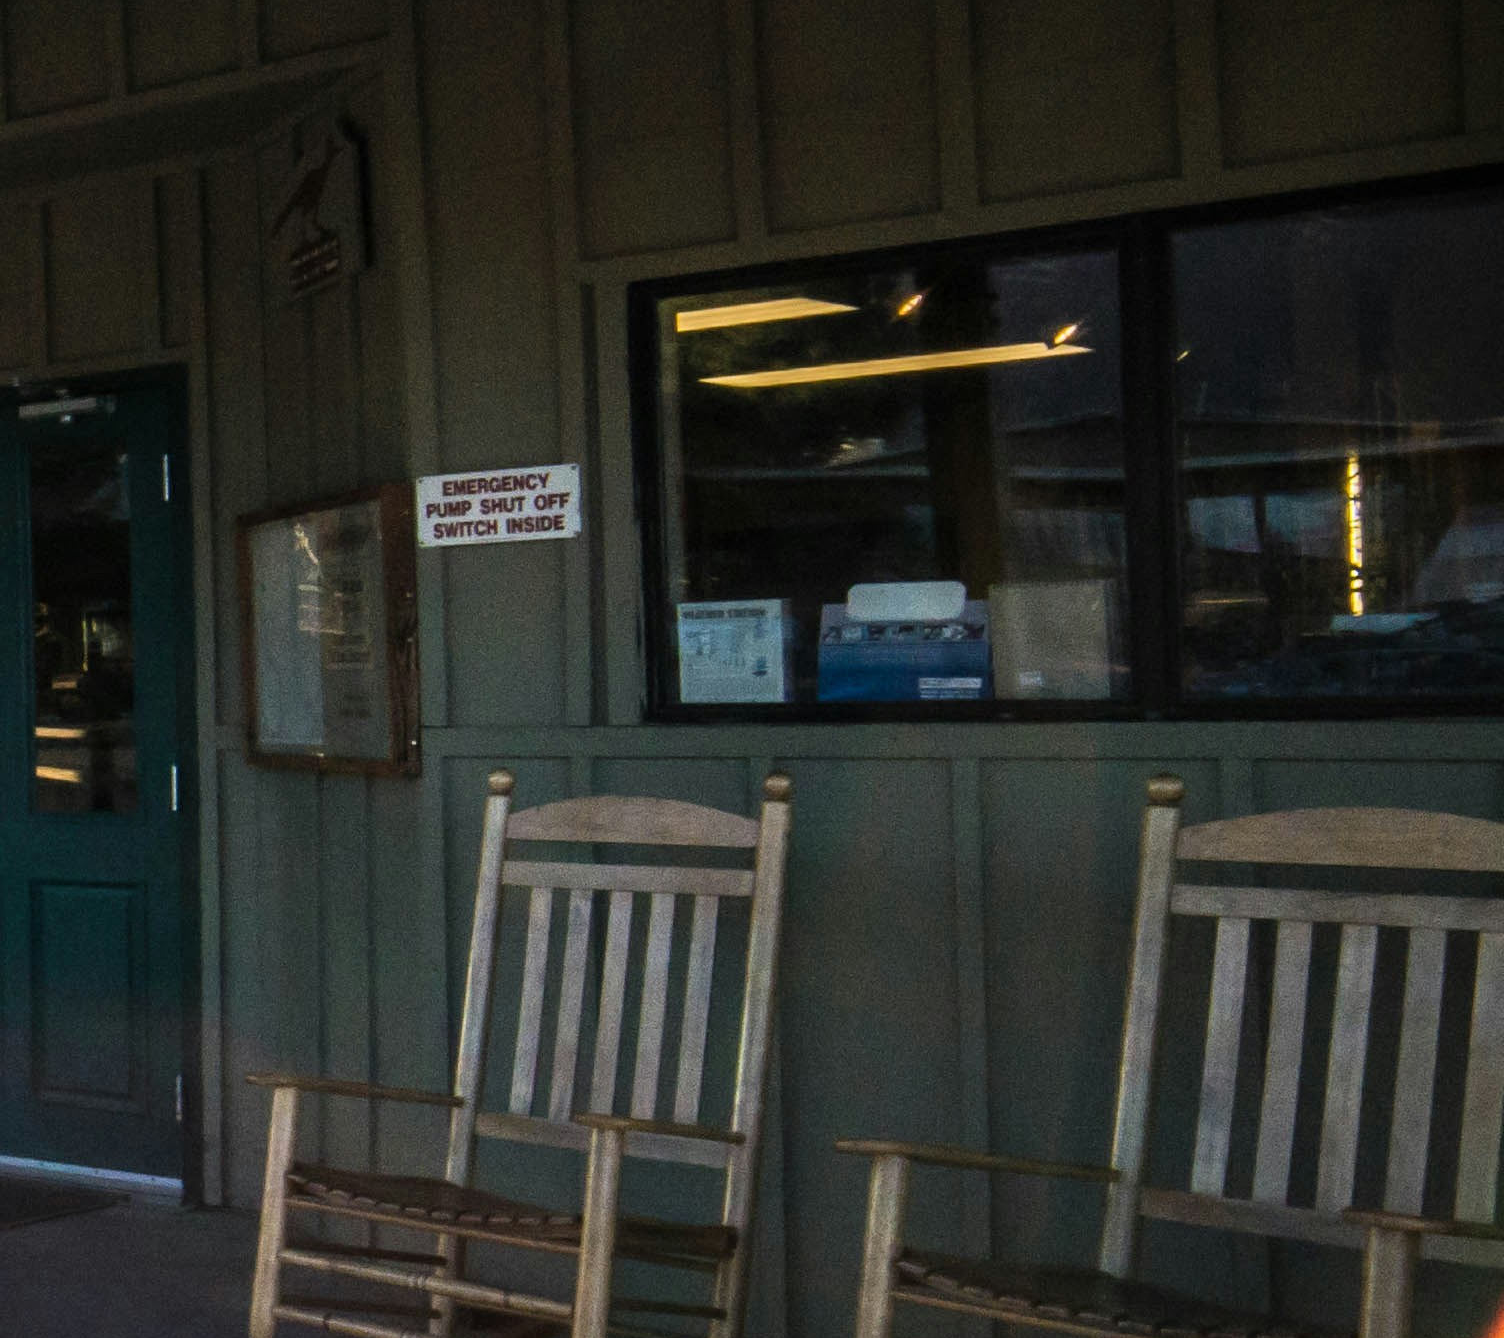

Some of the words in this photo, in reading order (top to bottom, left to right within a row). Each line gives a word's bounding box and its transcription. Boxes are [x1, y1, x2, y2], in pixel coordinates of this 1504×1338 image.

[442, 471, 551, 496] EMERGENCY
[426, 500, 472, 518] PUMP
[480, 496, 526, 514] SHUT
[534, 492, 570, 510] OFF
[433, 518, 499, 539] SWITCH
[506, 514, 565, 534] INSIDE
